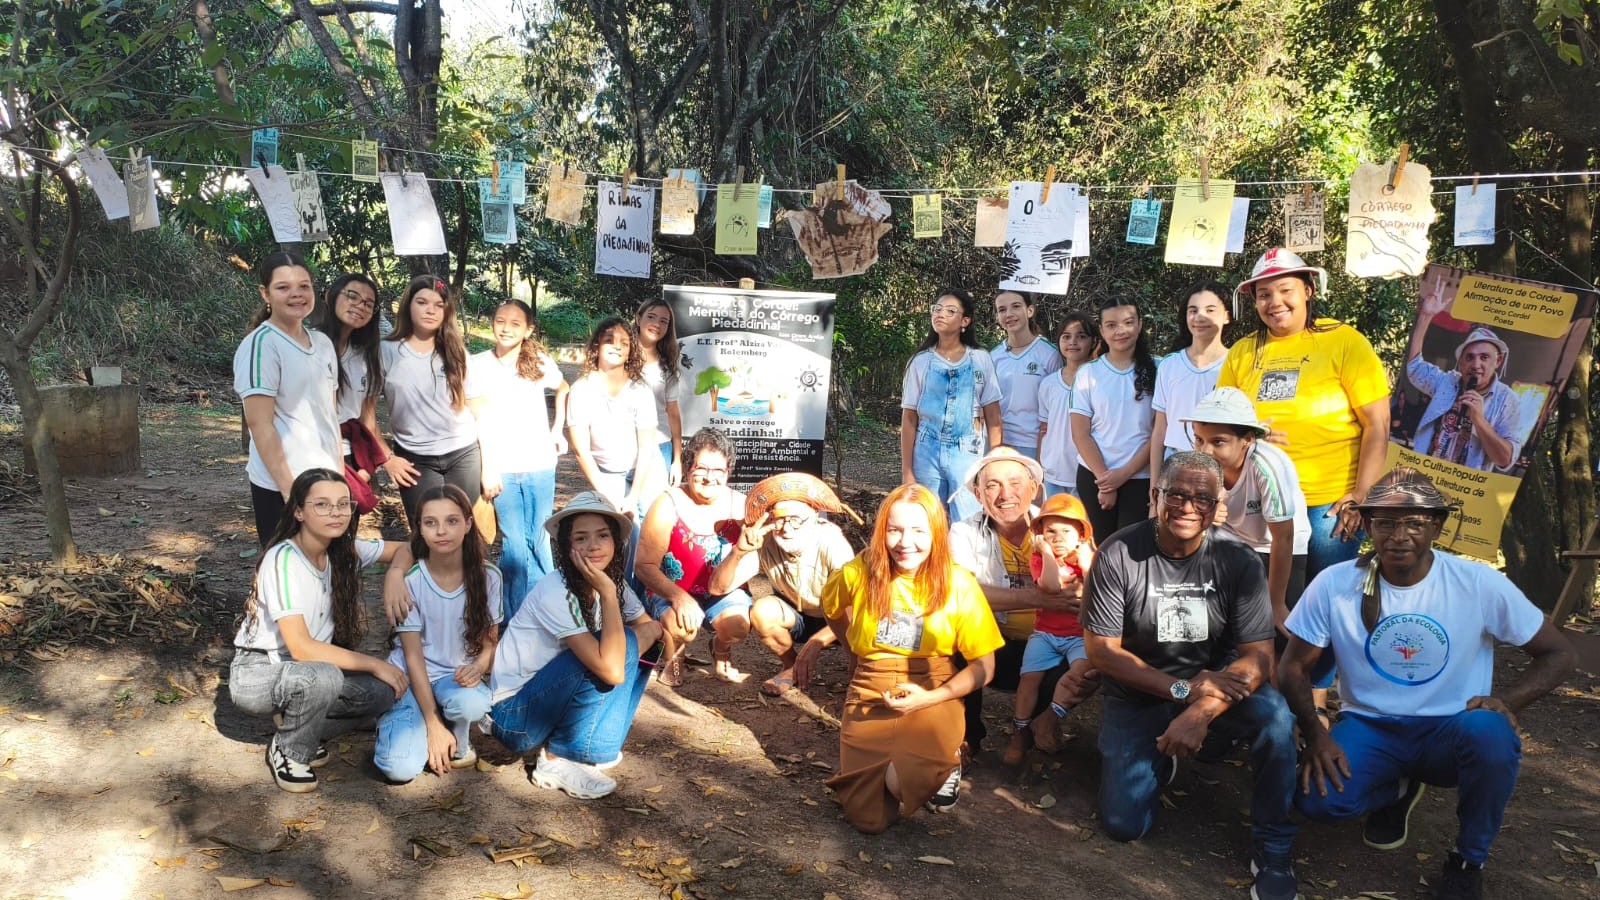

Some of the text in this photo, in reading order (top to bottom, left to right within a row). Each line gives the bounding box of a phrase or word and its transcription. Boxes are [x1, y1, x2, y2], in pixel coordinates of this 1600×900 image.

[1473, 280, 1562, 304] Literatura de Cordel
[1508, 310, 1531, 320] Cordel
[1509, 299, 1521, 308] de
[1522, 303, 1538, 311] um
[1540, 305, 1564, 317] Povo
[749, 309, 765, 320] do
[770, 309, 820, 325] Córrego
[1494, 316, 1514, 326] Poeta
[735, 447, 767, 455] emória
[770, 448, 809, 456] Ambiental
[788, 441, 812, 449] Cidade
[1452, 468, 1488, 484] Popular
[1435, 476, 1471, 494] Literatura
[1472, 487, 1485, 497] de
[1371, 618, 1401, 646] PASTORAL
[1415, 618, 1446, 645] ECOLOGIA
